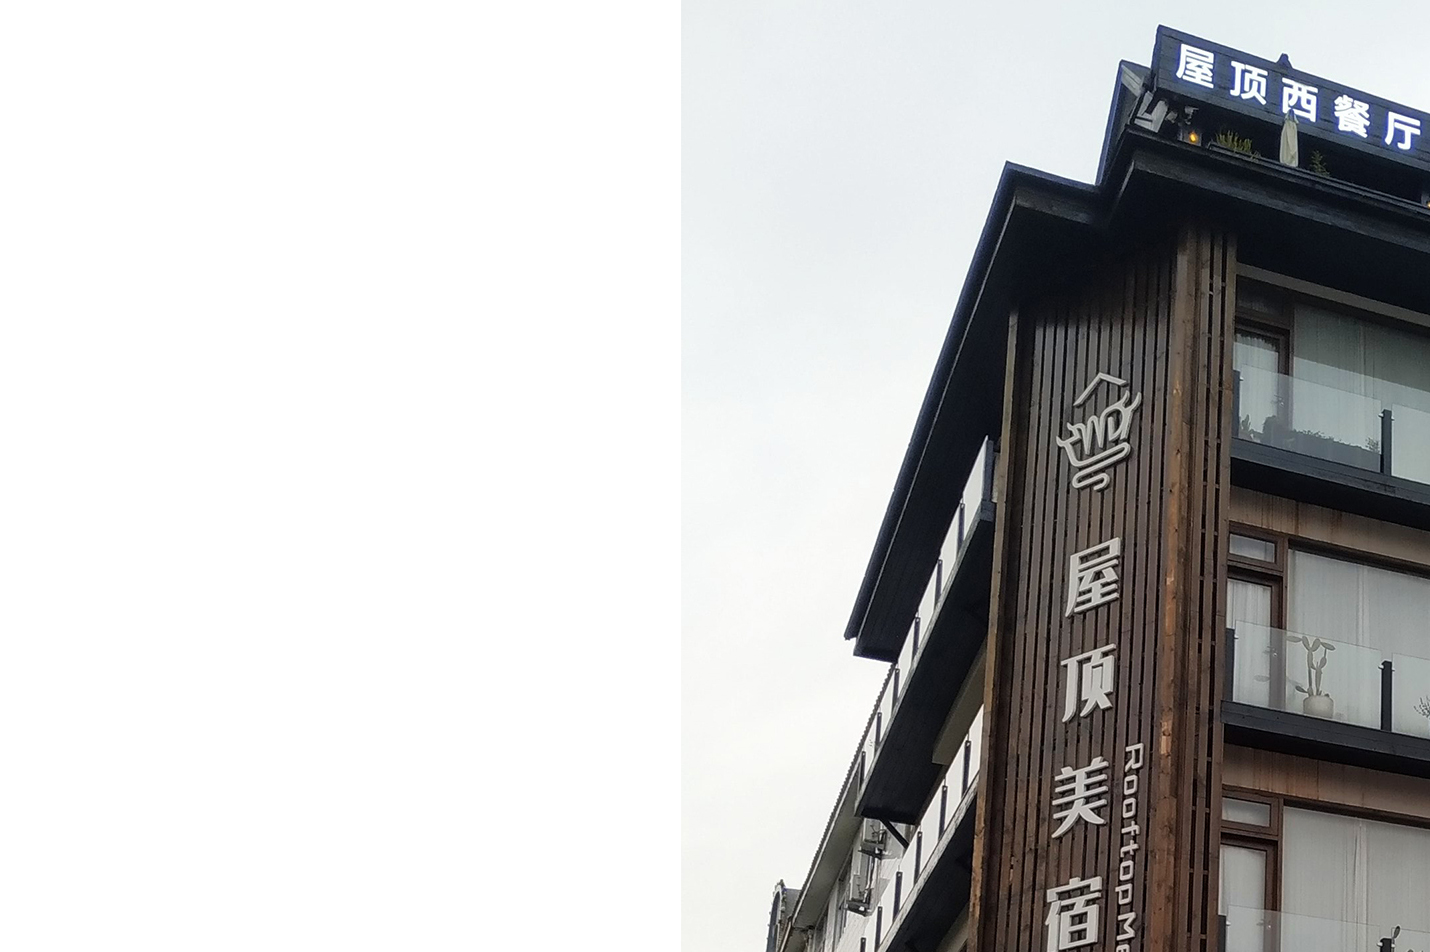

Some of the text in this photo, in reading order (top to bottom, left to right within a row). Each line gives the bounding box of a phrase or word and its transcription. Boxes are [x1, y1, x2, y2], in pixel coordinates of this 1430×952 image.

[1175, 42, 1422, 151] 屋顶西餐厅
[1115, 742, 1145, 906] Rooftop
